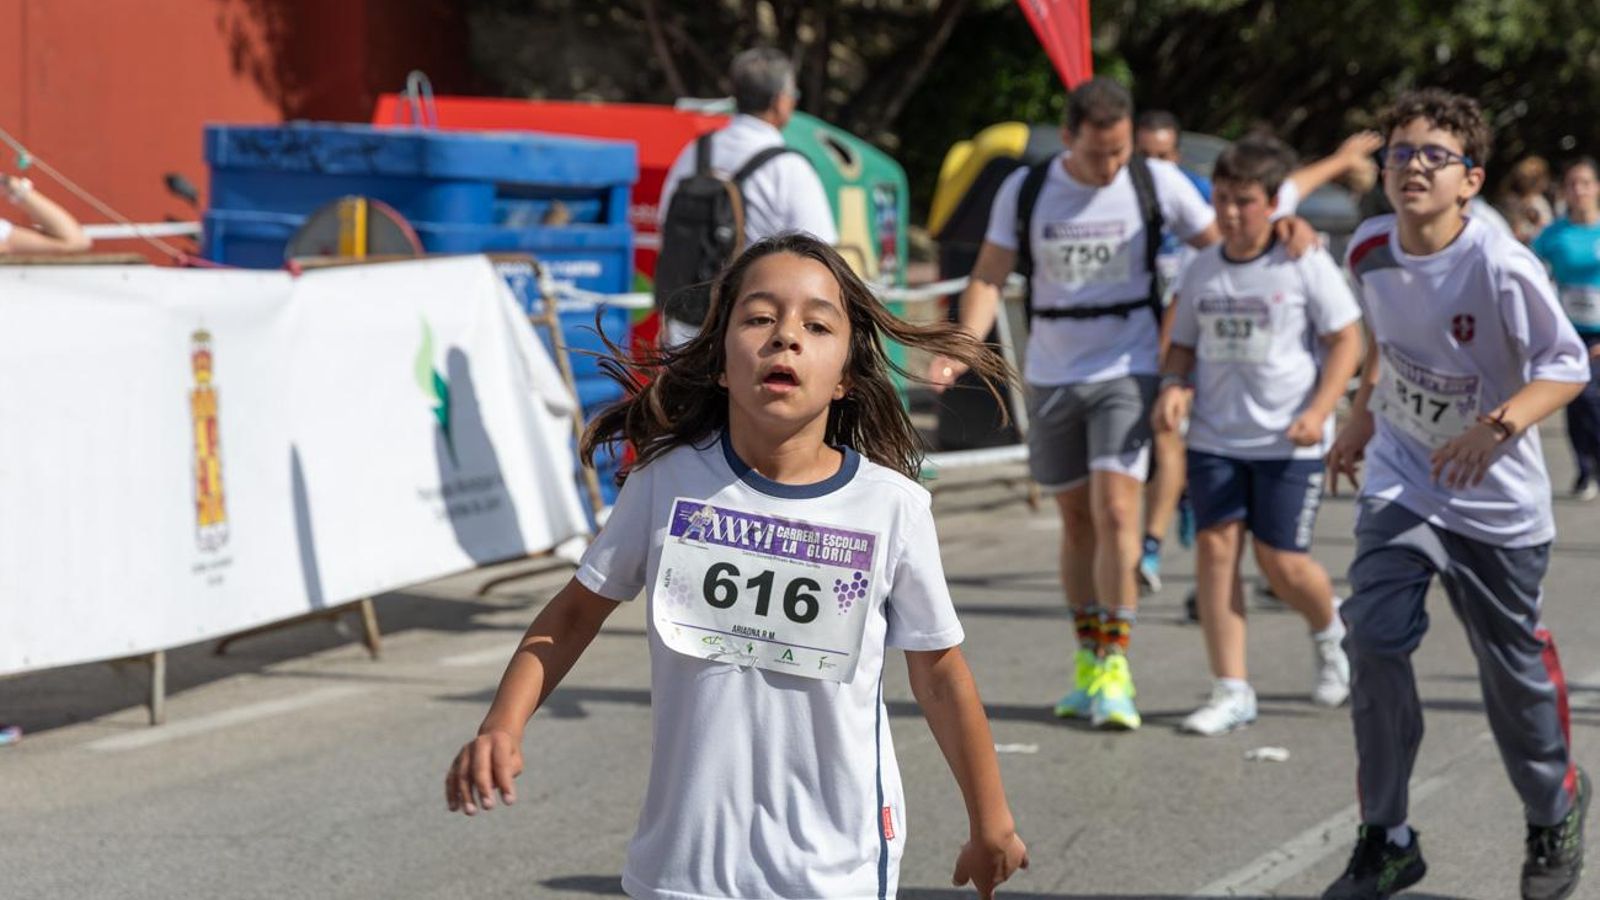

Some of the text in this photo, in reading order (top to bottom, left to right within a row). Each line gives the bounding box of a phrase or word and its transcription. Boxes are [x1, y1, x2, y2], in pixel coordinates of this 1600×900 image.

[1060, 243, 1110, 266] 750
[706, 513, 775, 549] XXXVI
[776, 526, 868, 552] CARRERA ESCOLAR
[782, 540, 798, 555] LA
[806, 544, 852, 563] GLORIA
[703, 561, 821, 624] 616
[732, 624, 760, 638] ARIADNA
